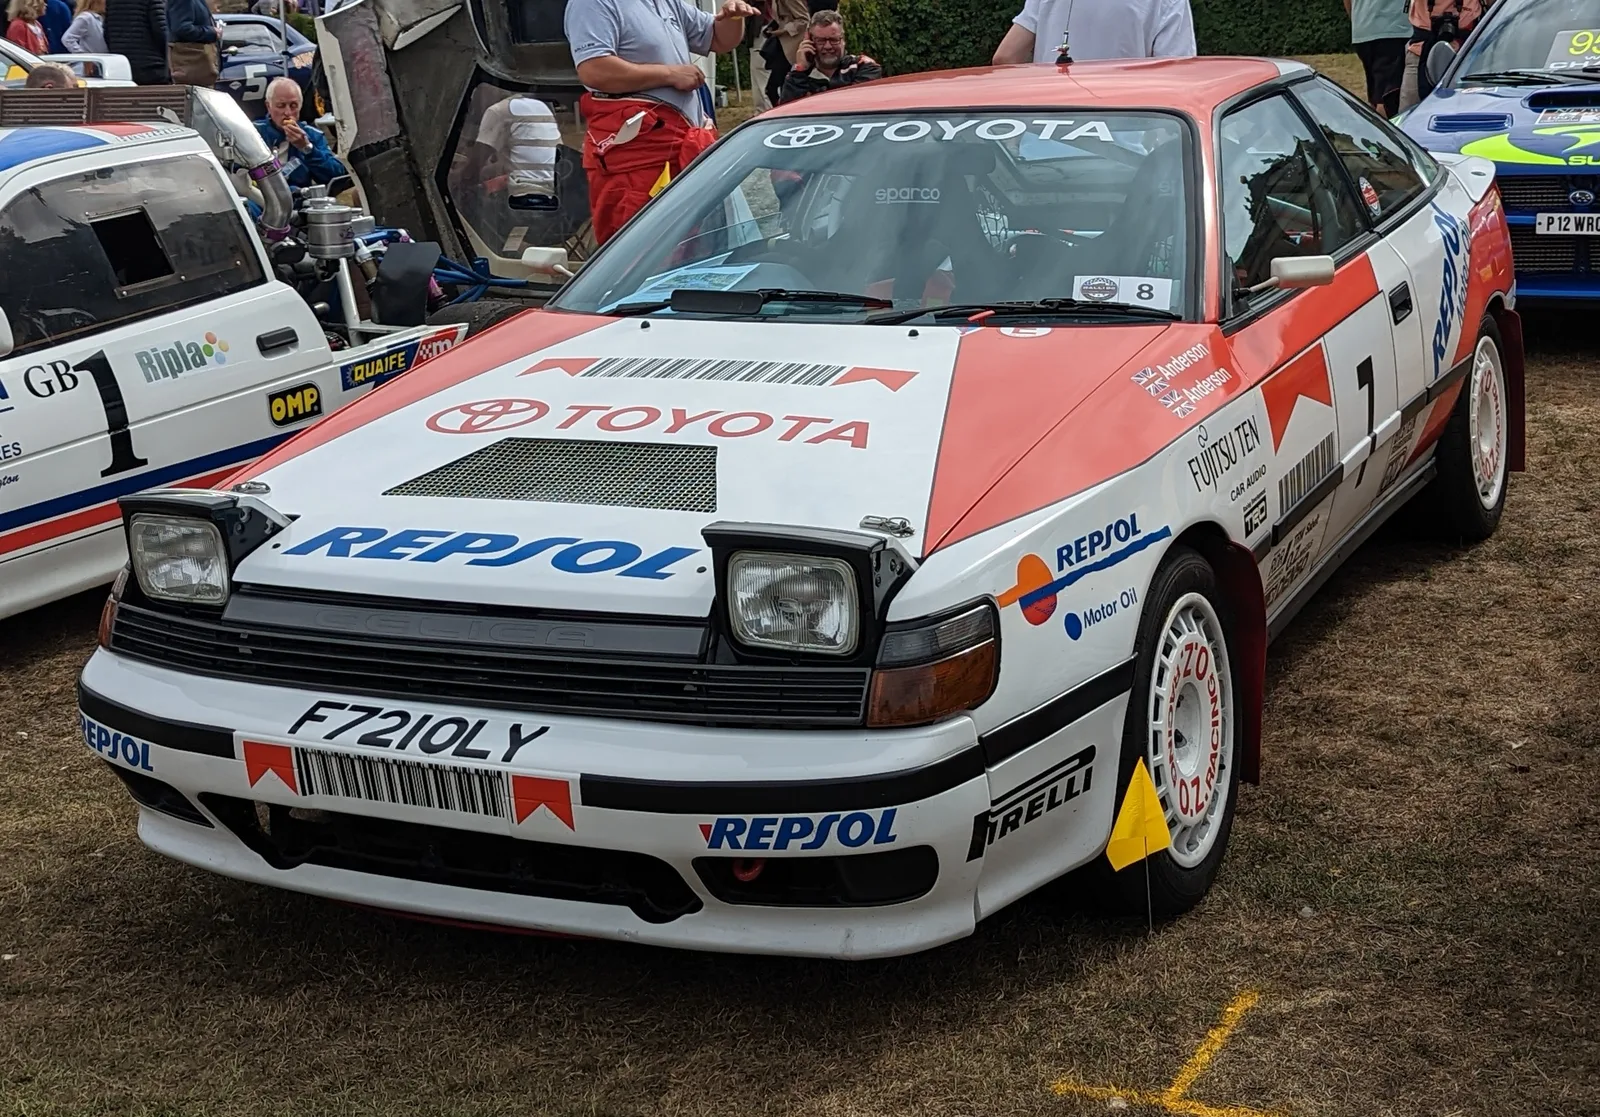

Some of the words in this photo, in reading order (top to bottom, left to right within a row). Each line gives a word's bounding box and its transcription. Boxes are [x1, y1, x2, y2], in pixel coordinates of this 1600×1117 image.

[242, 64, 267, 101] 5
[851, 119, 1114, 143] TOYOTA
[875, 187, 940, 204] sparco
[1136, 283, 1154, 301] 8
[23, 358, 79, 399] GB
[134, 339, 208, 384] Ripla
[353, 350, 406, 383] QUAIFE
[1158, 342, 1210, 381] Anderson
[271, 386, 318, 421] OMP
[1181, 366, 1233, 405] Anderson
[72, 348, 149, 478] 1
[555, 404, 873, 450] TOYOTA
[1187, 431, 1238, 493] FUJITSU
[1234, 414, 1261, 457] TEN
[1230, 482, 1246, 502] CAR
[1246, 464, 1267, 489] AUDIO
[281, 525, 703, 581] REPSOL
[1056, 513, 1142, 573] REPSOL
[1083, 595, 1120, 629] Motor
[1120, 586, 1138, 614] Oil
[314, 609, 596, 649] CELICA
[1205, 671, 1220, 790] RACING
[965, 744, 1097, 863] PIRELLI
[706, 807, 899, 852] REPSOL
